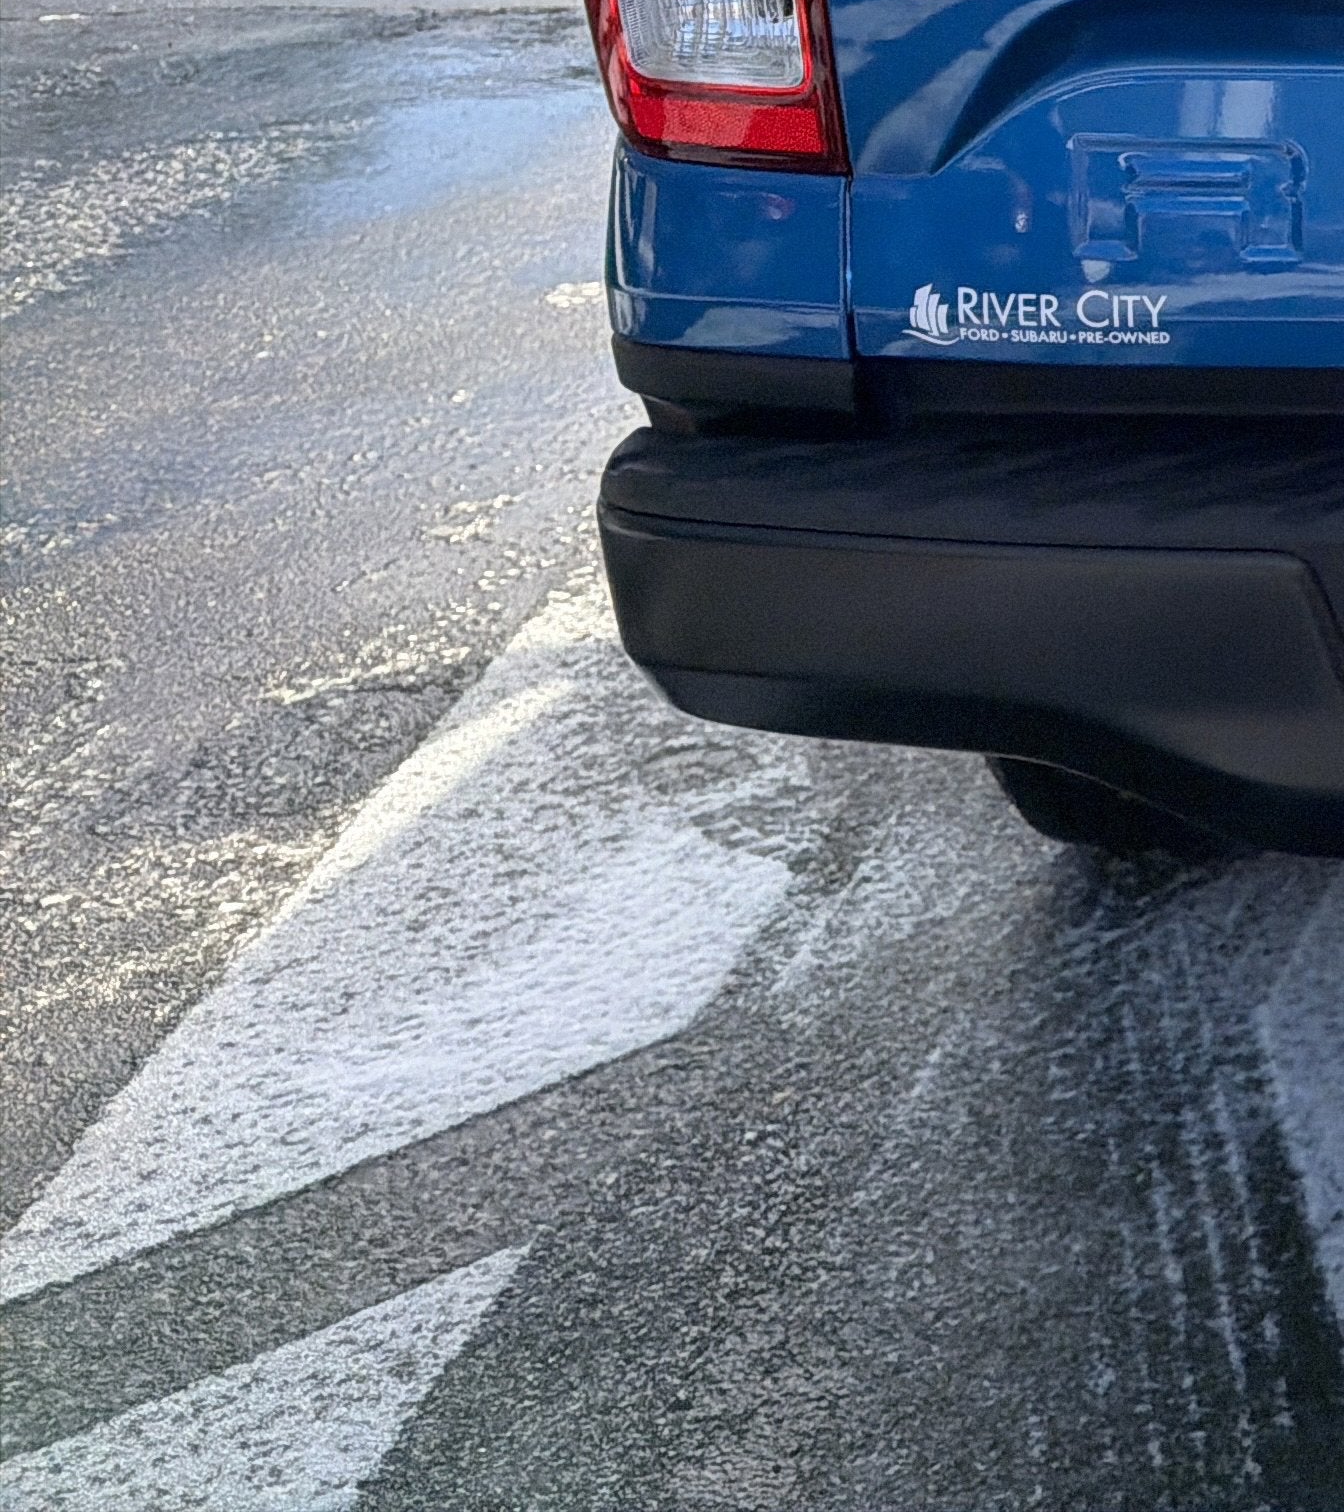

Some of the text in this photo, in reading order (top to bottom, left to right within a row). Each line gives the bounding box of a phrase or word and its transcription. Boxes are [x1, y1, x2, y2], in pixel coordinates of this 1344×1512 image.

[957, 287, 1167, 328] RIVER CITY
[959, 327, 1170, 344] FORD SUBARU PRE-OWNED
